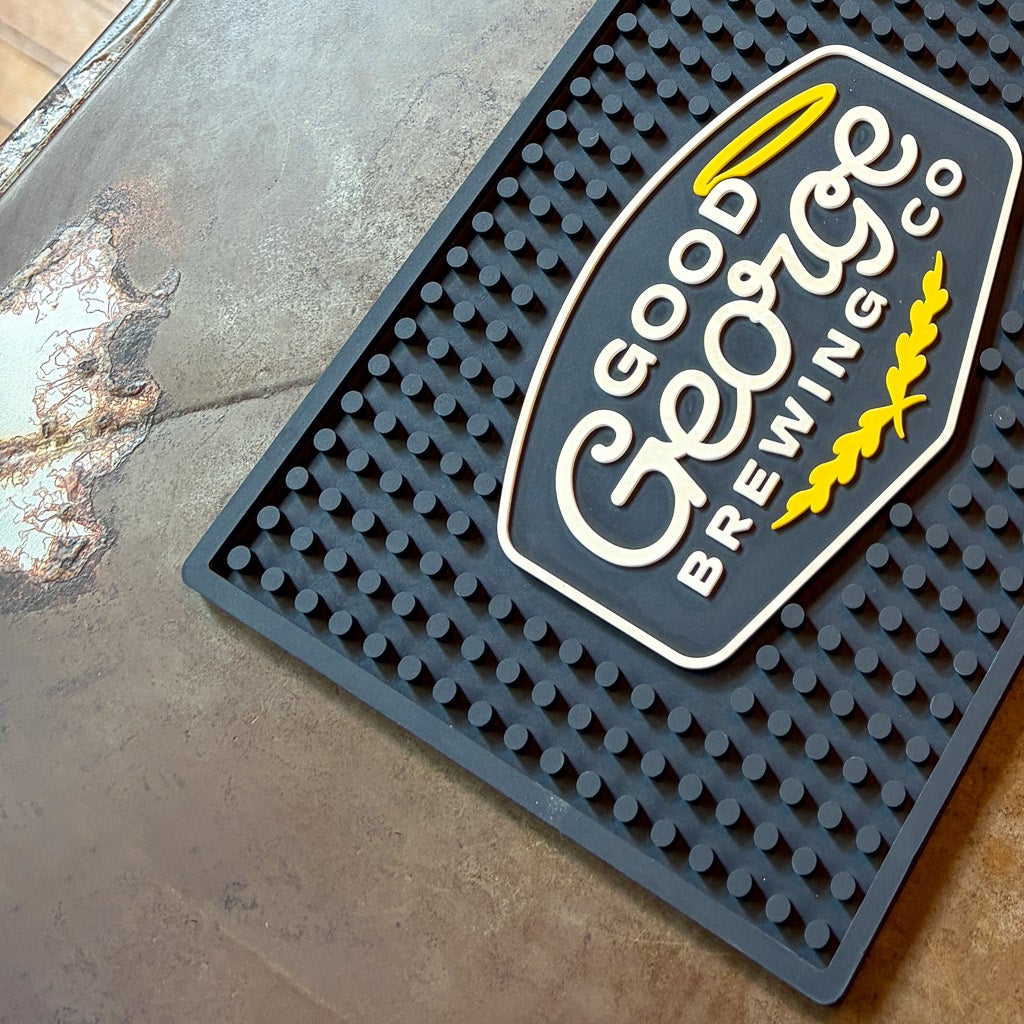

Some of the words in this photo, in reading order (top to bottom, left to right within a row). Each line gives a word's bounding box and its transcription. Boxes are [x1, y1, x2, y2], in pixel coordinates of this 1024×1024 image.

[555, 105, 919, 568] George
[593, 177, 759, 398] GOOD
[676, 286, 889, 598] BREWING
[900, 158, 964, 237] CO
